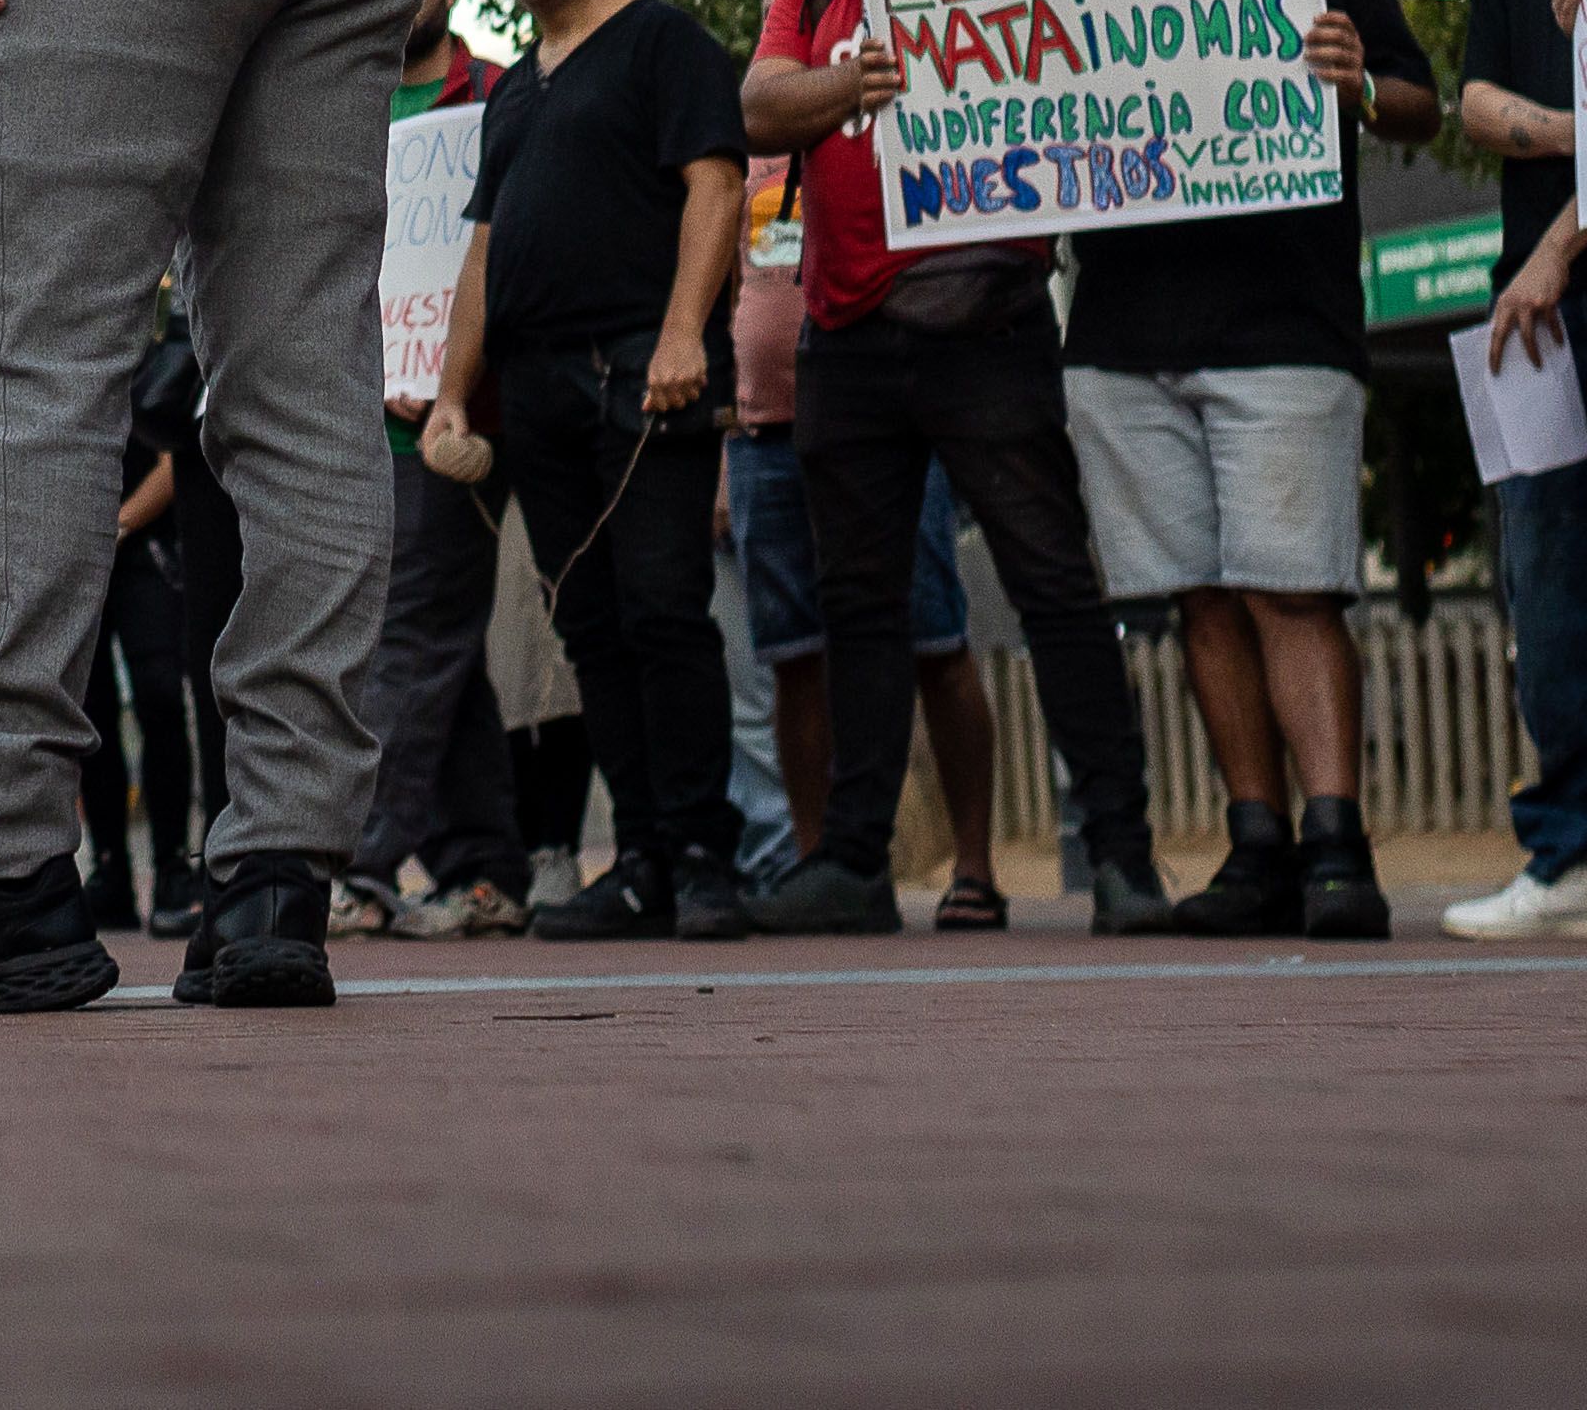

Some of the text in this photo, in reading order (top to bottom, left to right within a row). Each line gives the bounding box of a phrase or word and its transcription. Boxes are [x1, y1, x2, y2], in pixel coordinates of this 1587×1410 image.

[1224, 73, 1325, 133] CON
[900, 129, 1326, 228] NUESTROS VECINOS
